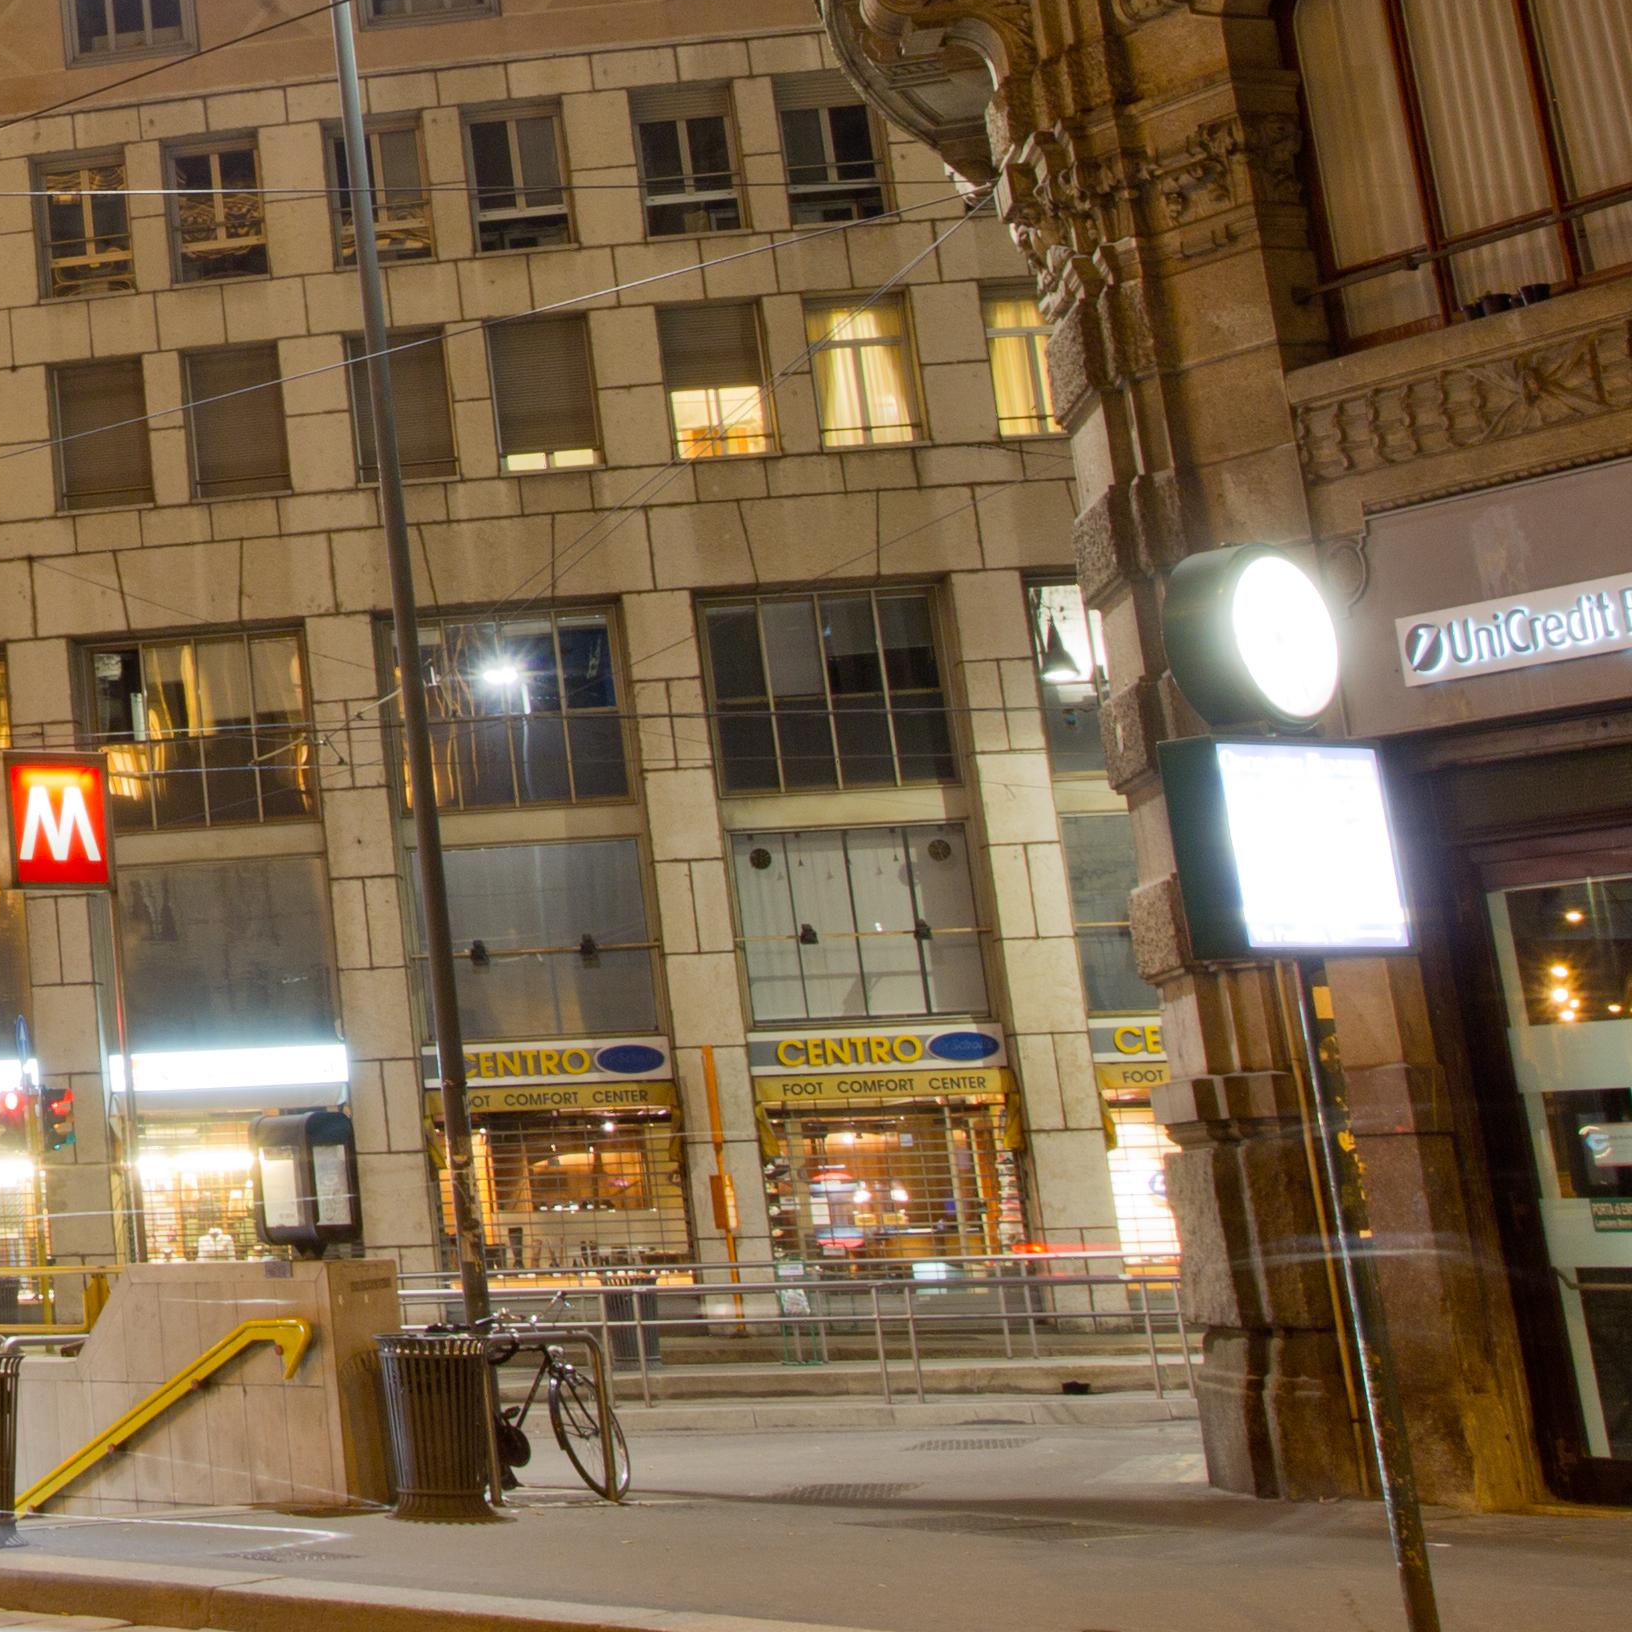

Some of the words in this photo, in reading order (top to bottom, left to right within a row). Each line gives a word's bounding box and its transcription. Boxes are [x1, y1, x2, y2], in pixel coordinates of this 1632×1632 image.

[1447, 591, 1618, 664] UniCredit
[19, 785, 101, 862] M
[776, 1034, 924, 1067] CENTRO
[782, 1081, 824, 1096] FOOT
[837, 1078, 915, 1094] COMFORT
[928, 1076, 986, 1090] CENTER
[1122, 1070, 1164, 1083] FOOT
[504, 1091, 579, 1106] COMFORT
[592, 1089, 649, 1104] CENTER
